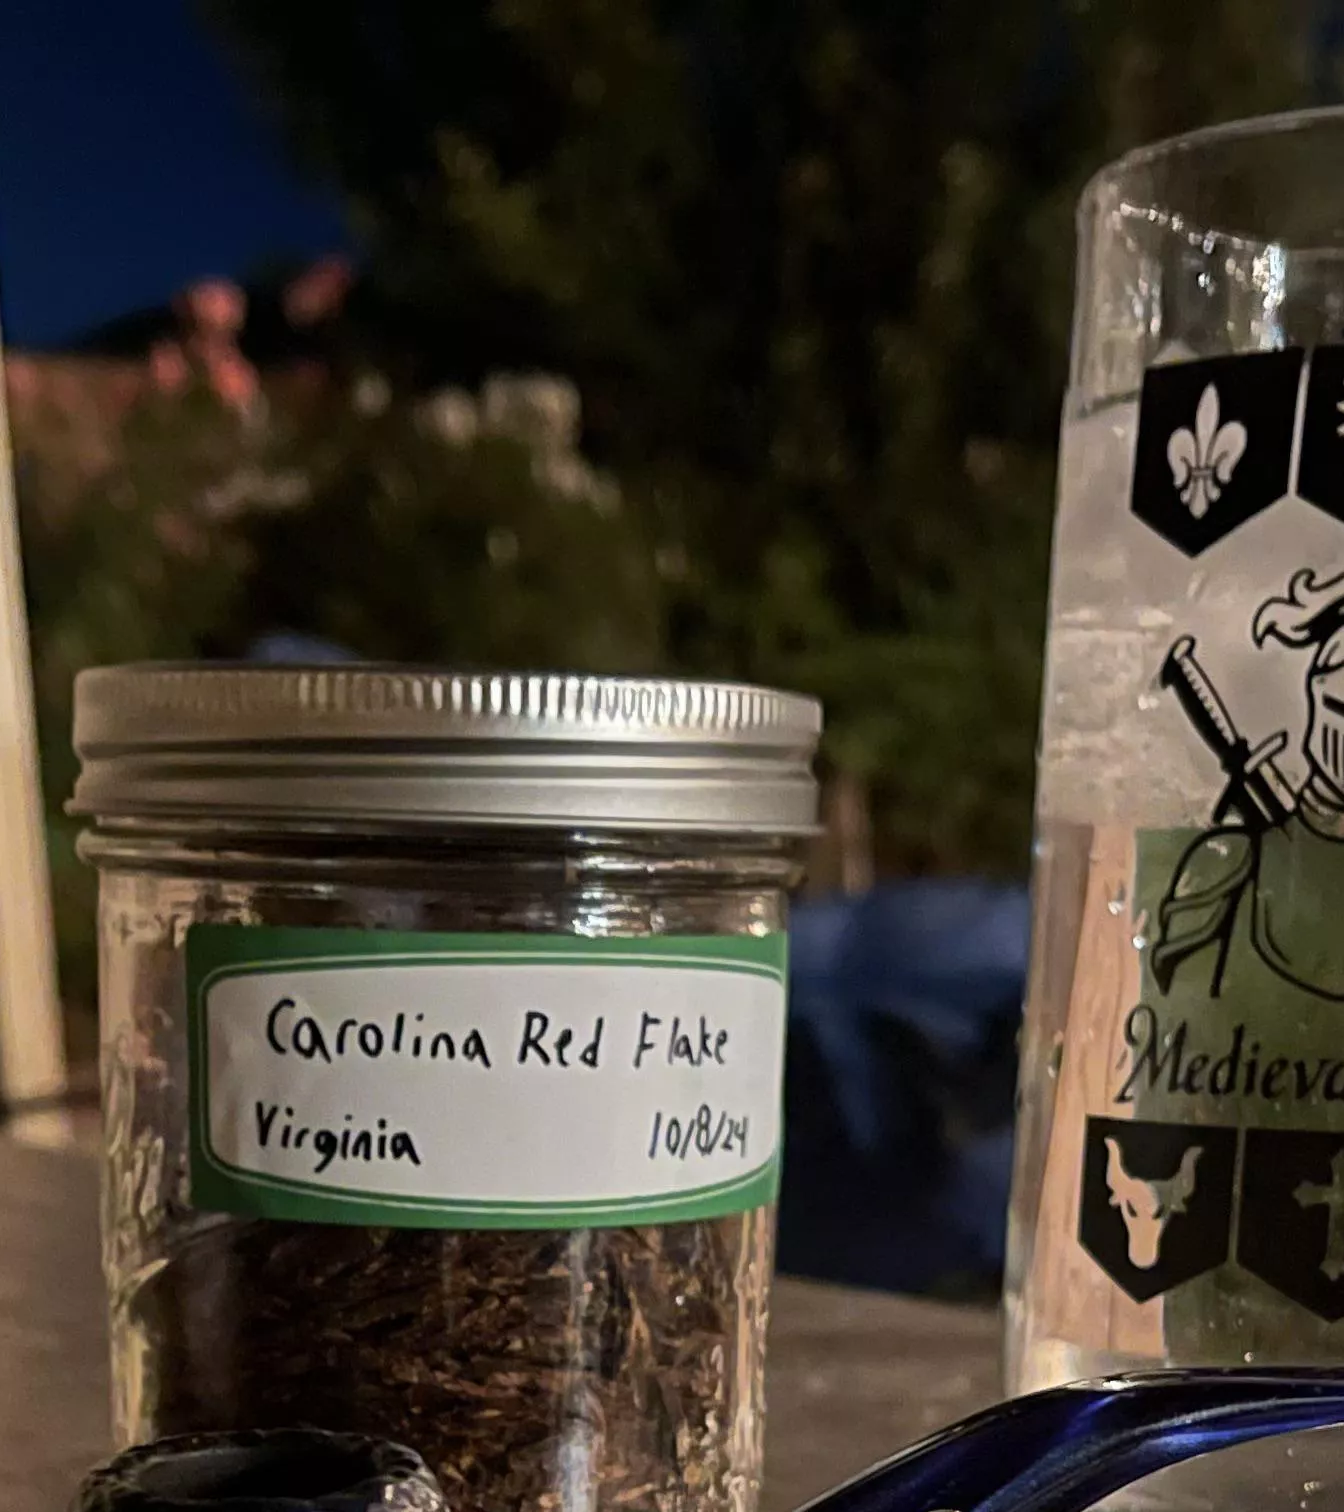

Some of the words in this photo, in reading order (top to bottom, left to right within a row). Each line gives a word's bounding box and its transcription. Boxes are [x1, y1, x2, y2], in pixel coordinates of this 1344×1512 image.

[266, 998, 492, 1069] Carolina
[517, 1010, 604, 1069] Red
[633, 1010, 729, 1069] Flake
[253, 1101, 422, 1172] Virginia
[647, 1103, 749, 1160] 10/8/24
